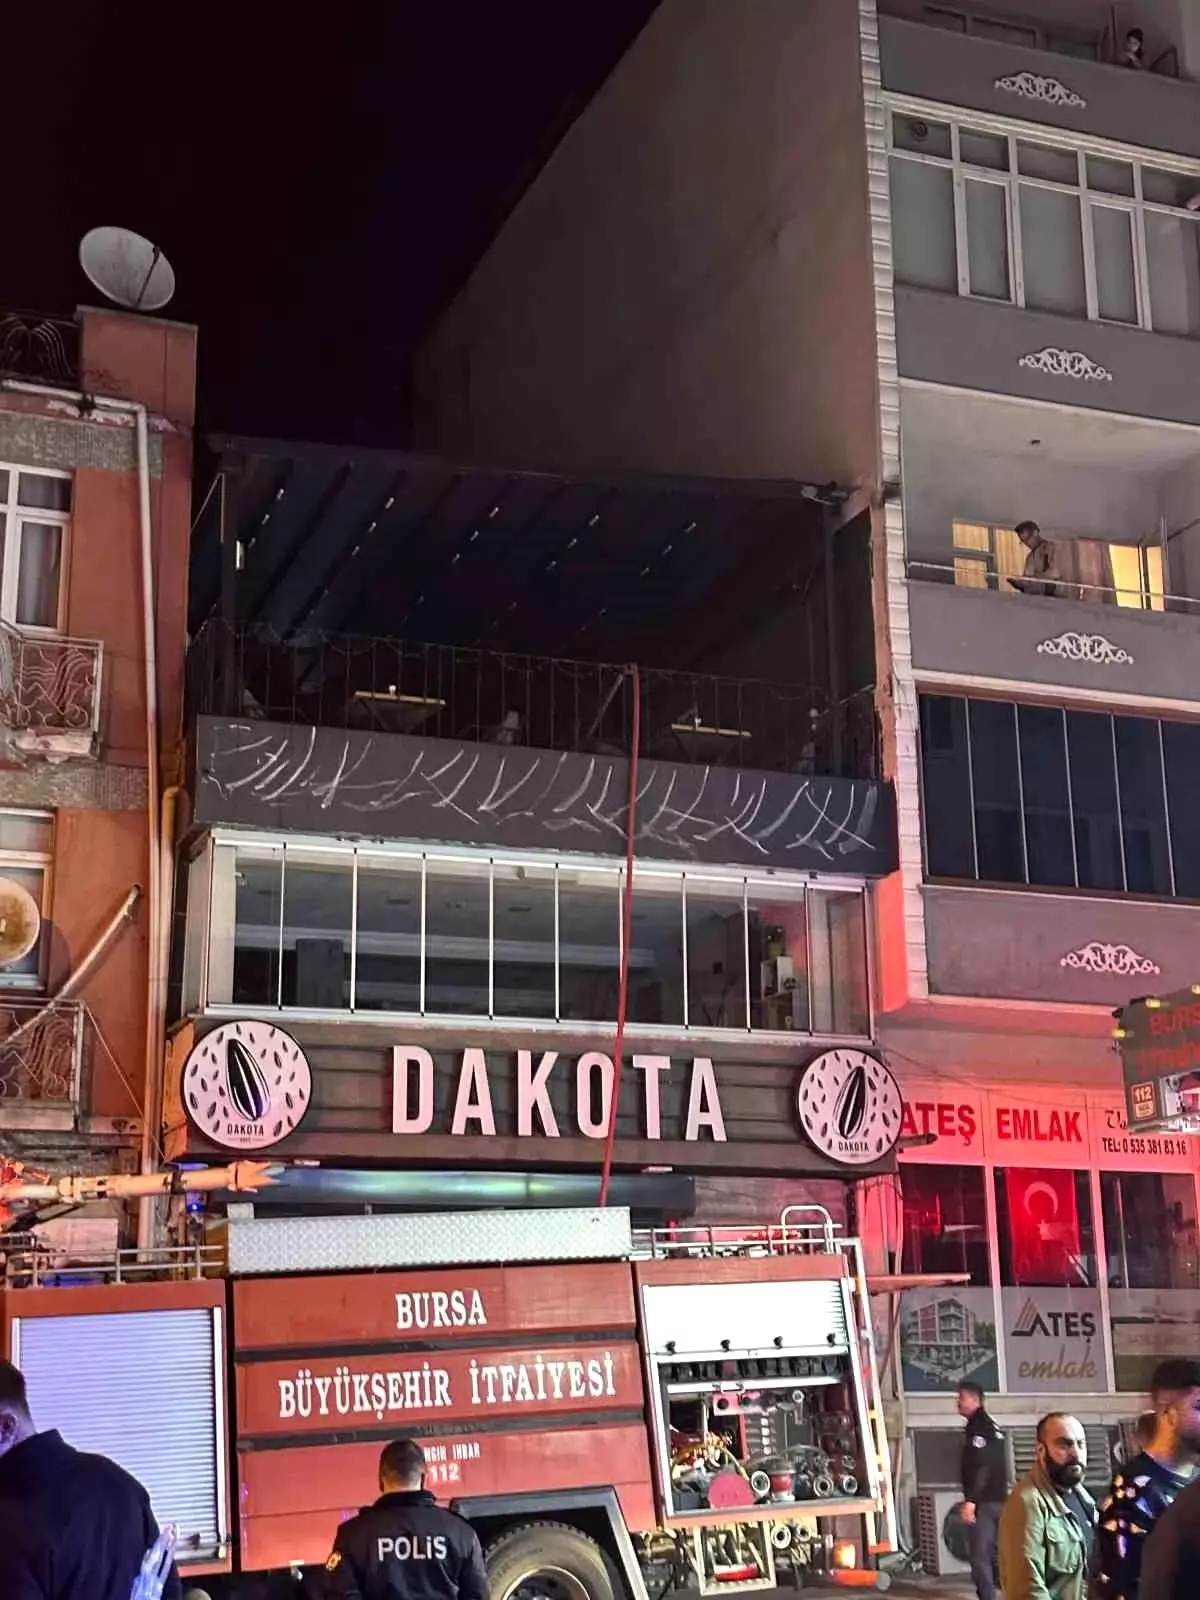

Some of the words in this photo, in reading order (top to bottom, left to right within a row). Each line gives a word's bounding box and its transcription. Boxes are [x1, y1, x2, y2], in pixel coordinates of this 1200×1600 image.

[391, 1044, 728, 1142] DAKOTA
[1134, 1086, 1152, 1102] 112
[227, 1123, 264, 1136] DAKOTA
[902, 1101, 977, 1146] ATEŞ
[996, 1108, 1083, 1142] EMLAK
[838, 1141, 870, 1152] DAKOTA
[1102, 1137, 1120, 1152] TEL:
[1122, 1138, 1129, 1153] 0
[1130, 1138, 1146, 1155] 535
[396, 1290, 486, 1328] BURSA
[1011, 1311, 1097, 1344] ATEŞ
[1018, 1343, 1097, 1379] emlak
[278, 1360, 453, 1420] BÜYÜKŞEHİR
[469, 1352, 616, 1404] İTFAİYESİ
[424, 1445, 447, 1462] NGIN
[431, 1463, 459, 1481] 112
